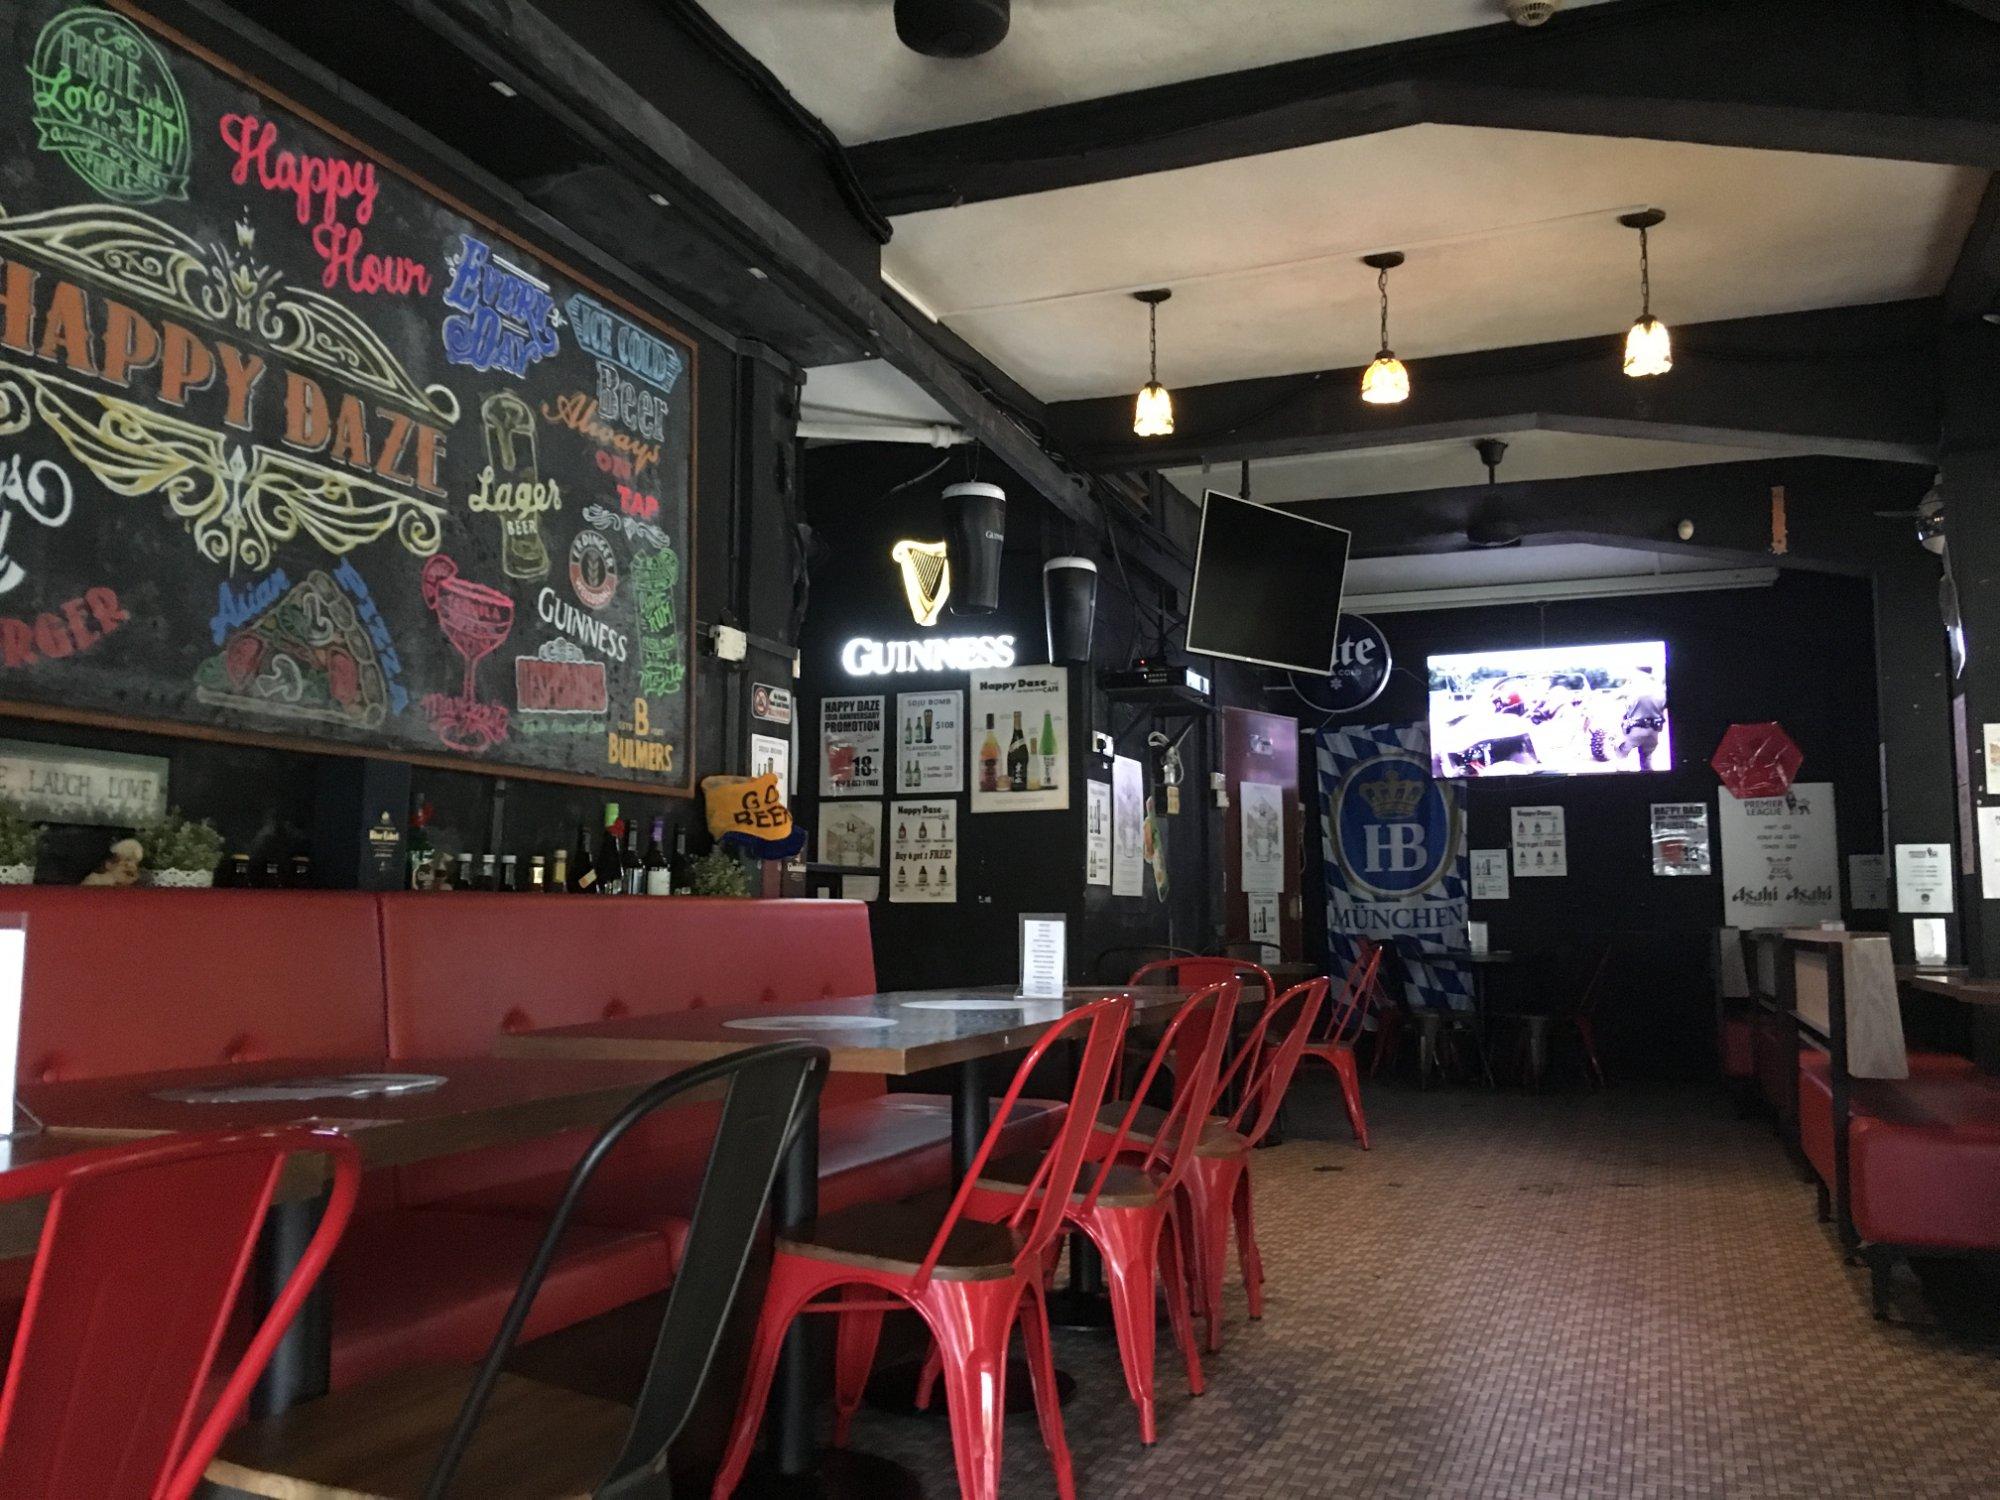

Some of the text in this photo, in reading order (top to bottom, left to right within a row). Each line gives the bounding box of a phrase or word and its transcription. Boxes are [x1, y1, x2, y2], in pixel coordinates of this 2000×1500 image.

[60, 27, 142, 104] PEOPLE
[25, 62, 116, 124] Love
[136, 107, 181, 166] EAT
[220, 113, 380, 225] Happy
[312, 221, 433, 297] Hour
[617, 325, 668, 381] COLD
[0, 257, 448, 498] HAPPY DAZE
[596, 359, 669, 443] Beer
[541, 391, 662, 477] Always
[467, 465, 563, 520] Lager
[616, 484, 660, 519] TAP
[506, 518, 538, 536] BEER
[537, 586, 629, 663] GUINNESS
[842, 635, 1016, 677] GUINNESS
[1337, 668, 1362, 677] COLD
[825, 700, 880, 712] HAPPY DAZE
[928, 698, 952, 706] BOMB
[979, 681, 1017, 692] Happy
[634, 697, 649, 736] B
[825, 721, 880, 732] PROMOTION
[607, 732, 674, 773] BULMERS
[29, 769, 91, 798] LAUGH
[108, 776, 153, 800] LOVE
[1744, 799, 1783, 809] PREMIER
[898, 806, 921, 816] Happy
[1745, 807, 1783, 816] LEAGUE
[1363, 823, 1428, 873] HB
[1731, 885, 1833, 902] Asahi Asahi
[1331, 903, 1465, 931] MÜNCHEN
